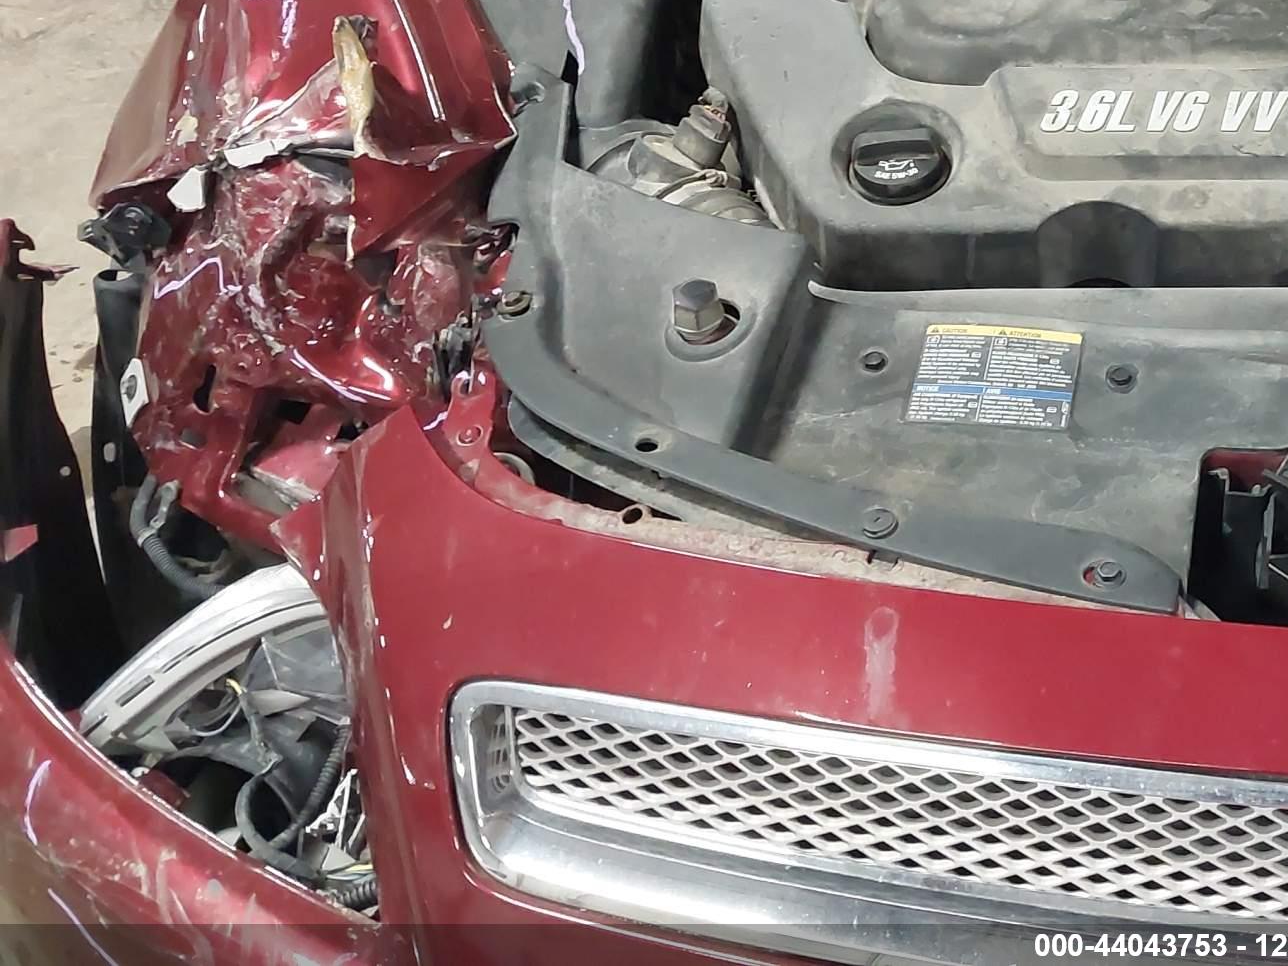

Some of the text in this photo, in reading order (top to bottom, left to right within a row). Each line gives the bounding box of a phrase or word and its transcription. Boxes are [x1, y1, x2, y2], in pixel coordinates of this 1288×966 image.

[1040, 89, 1135, 132] 3.6L
[1147, 90, 1210, 132] V6
[874, 170, 891, 180] SAE
[1009, 330, 1042, 338] ATTENTION
